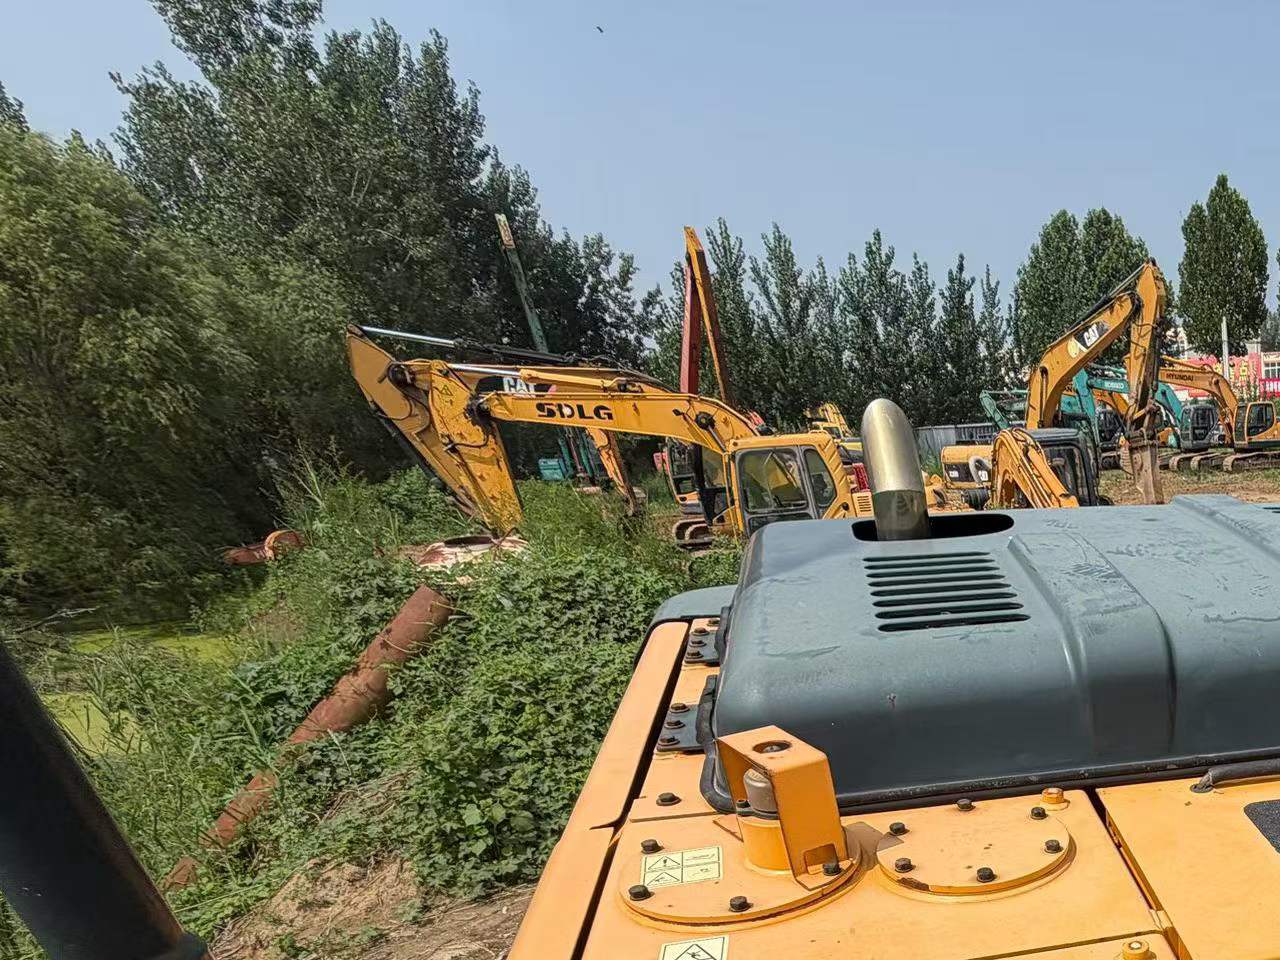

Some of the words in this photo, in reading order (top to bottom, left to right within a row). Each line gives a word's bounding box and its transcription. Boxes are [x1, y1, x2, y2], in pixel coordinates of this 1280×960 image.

[1083, 324, 1099, 346] CAT
[1165, 373, 1194, 382] HYUNDAI
[535, 402, 613, 420] SDLG
